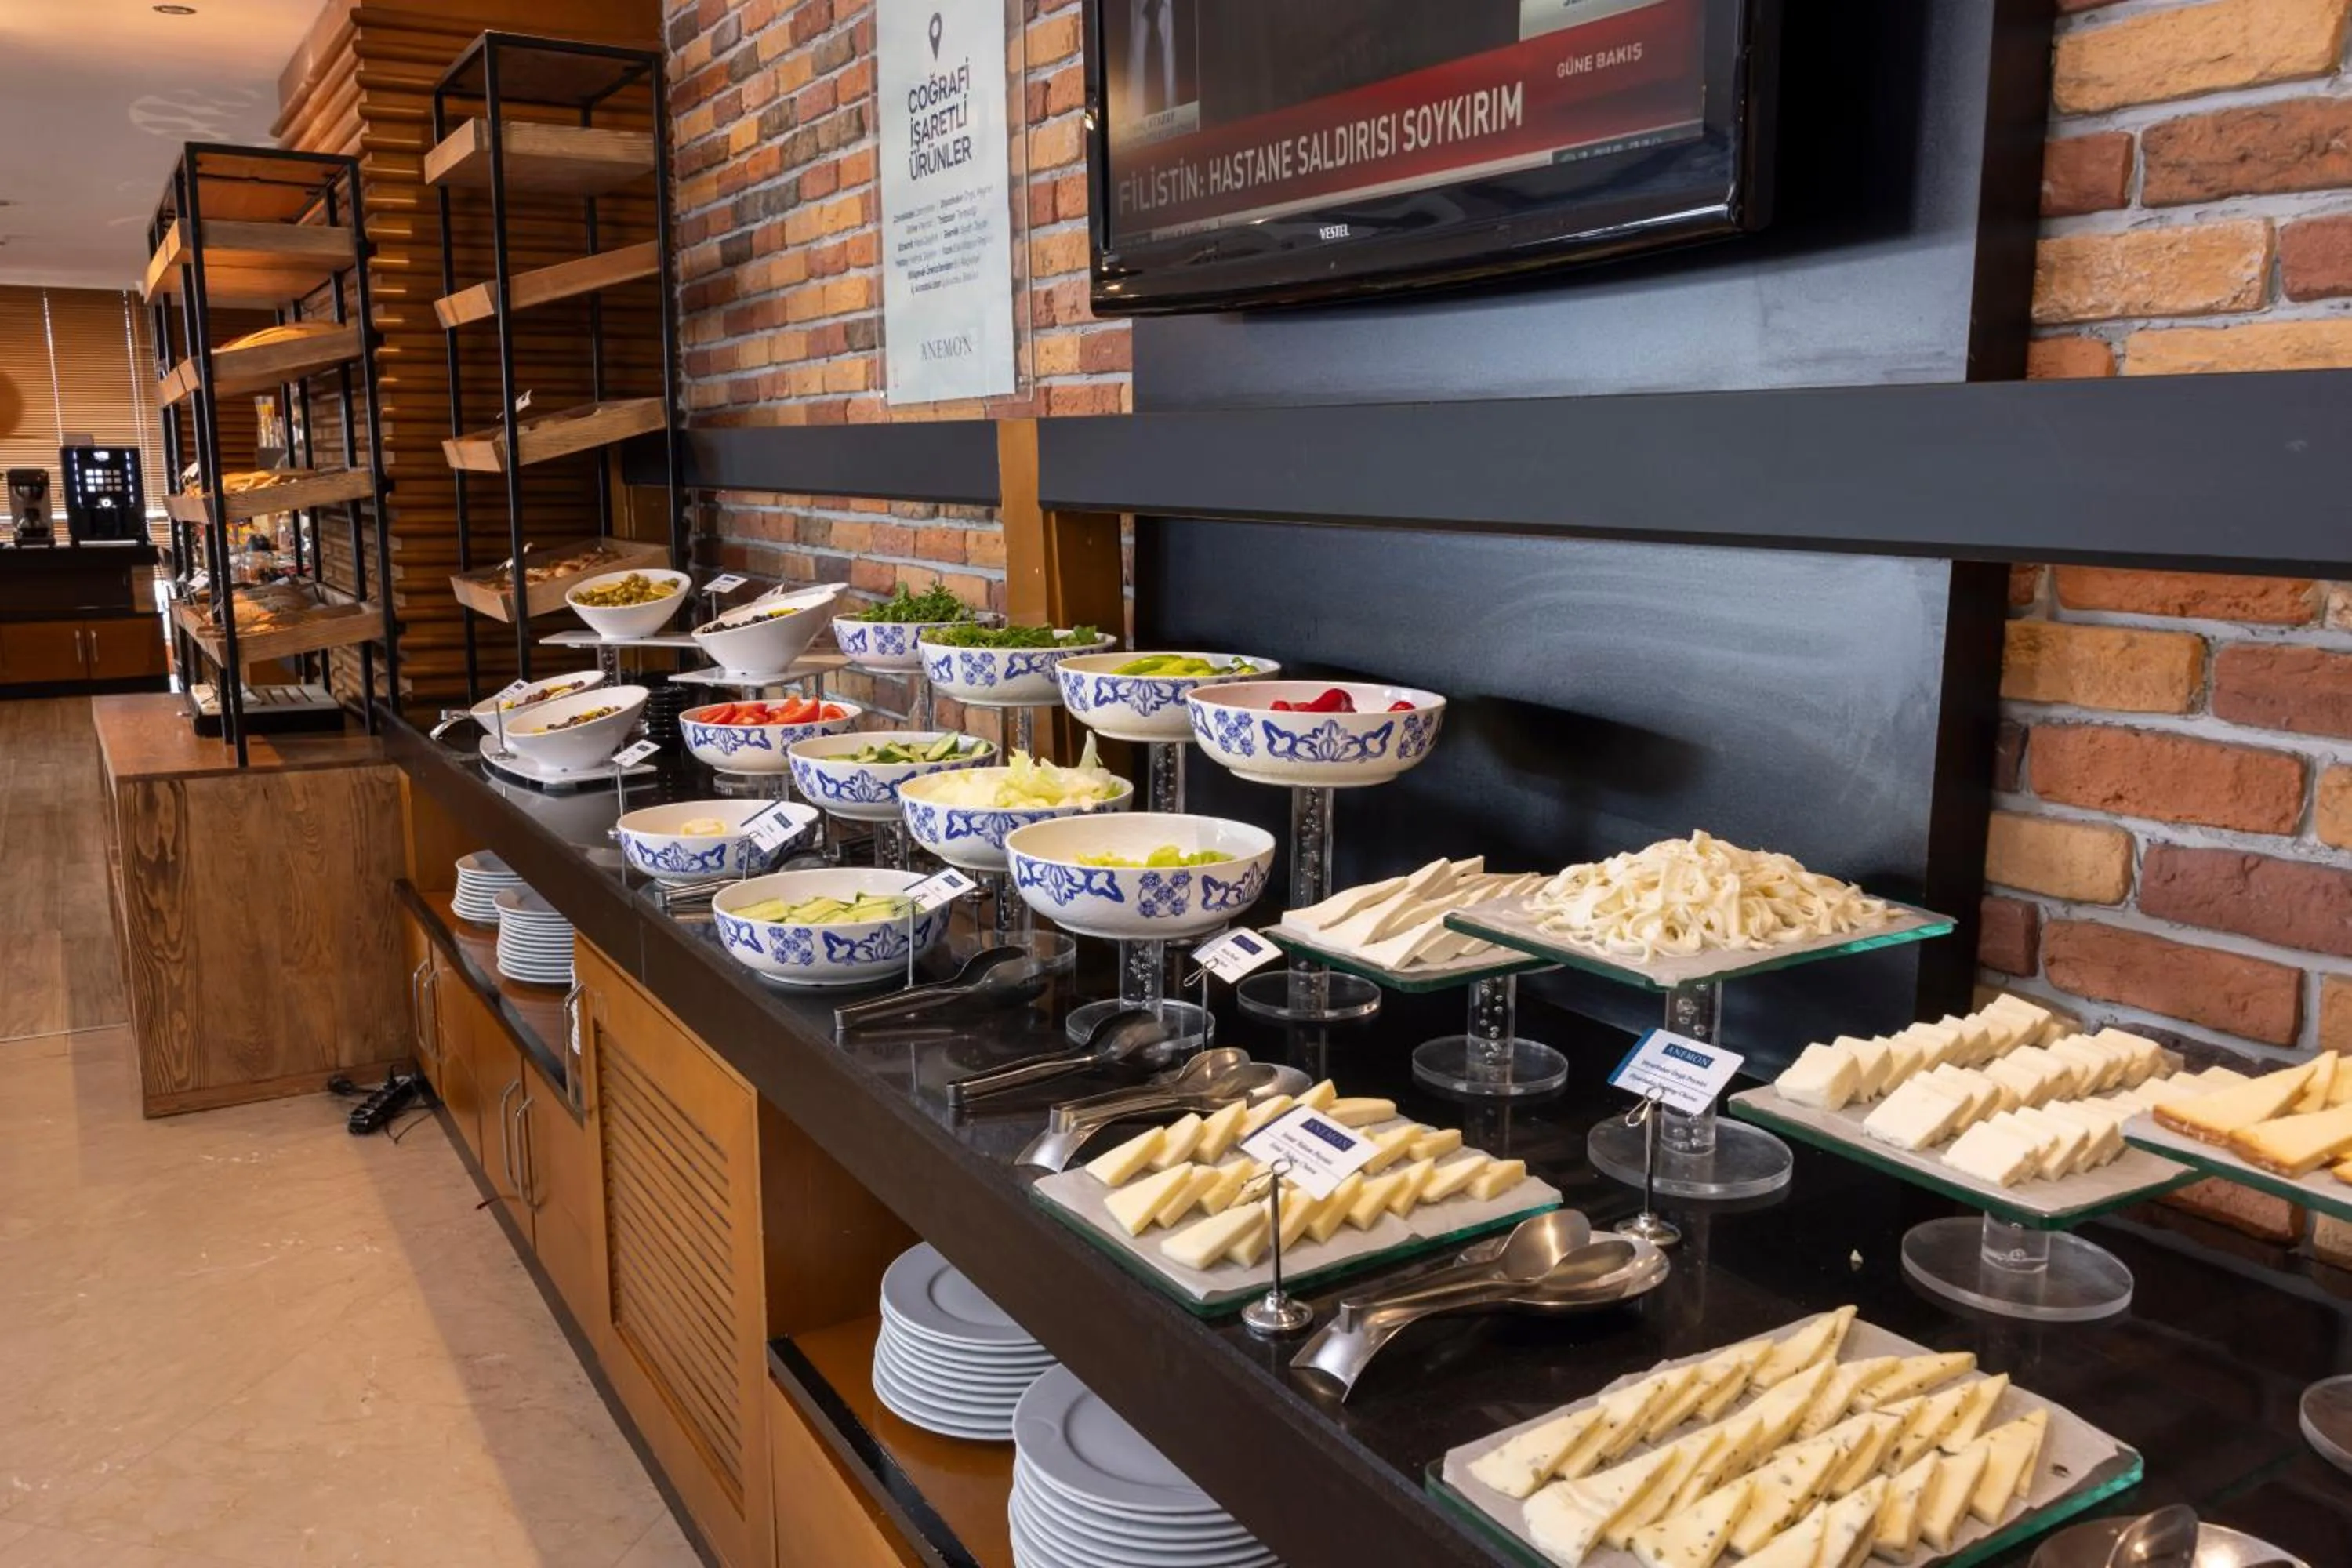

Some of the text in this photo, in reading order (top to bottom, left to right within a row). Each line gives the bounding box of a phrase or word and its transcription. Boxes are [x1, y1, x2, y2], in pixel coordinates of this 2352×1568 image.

[908, 56, 971, 114] COĞRAFİ
[909, 93, 968, 152] İŞARETLİ
[908, 136, 973, 181] ÜRÜNLER
[1118, 158, 1205, 216] FİLİSTİN:
[1209, 139, 1294, 195] HASTANE
[1298, 112, 1396, 176] SALDIRISI
[1403, 81, 1523, 151] SOYKIRIM
[1319, 223, 1351, 240] VESTEL
[1667, 1046, 1711, 1067] ANEMON
